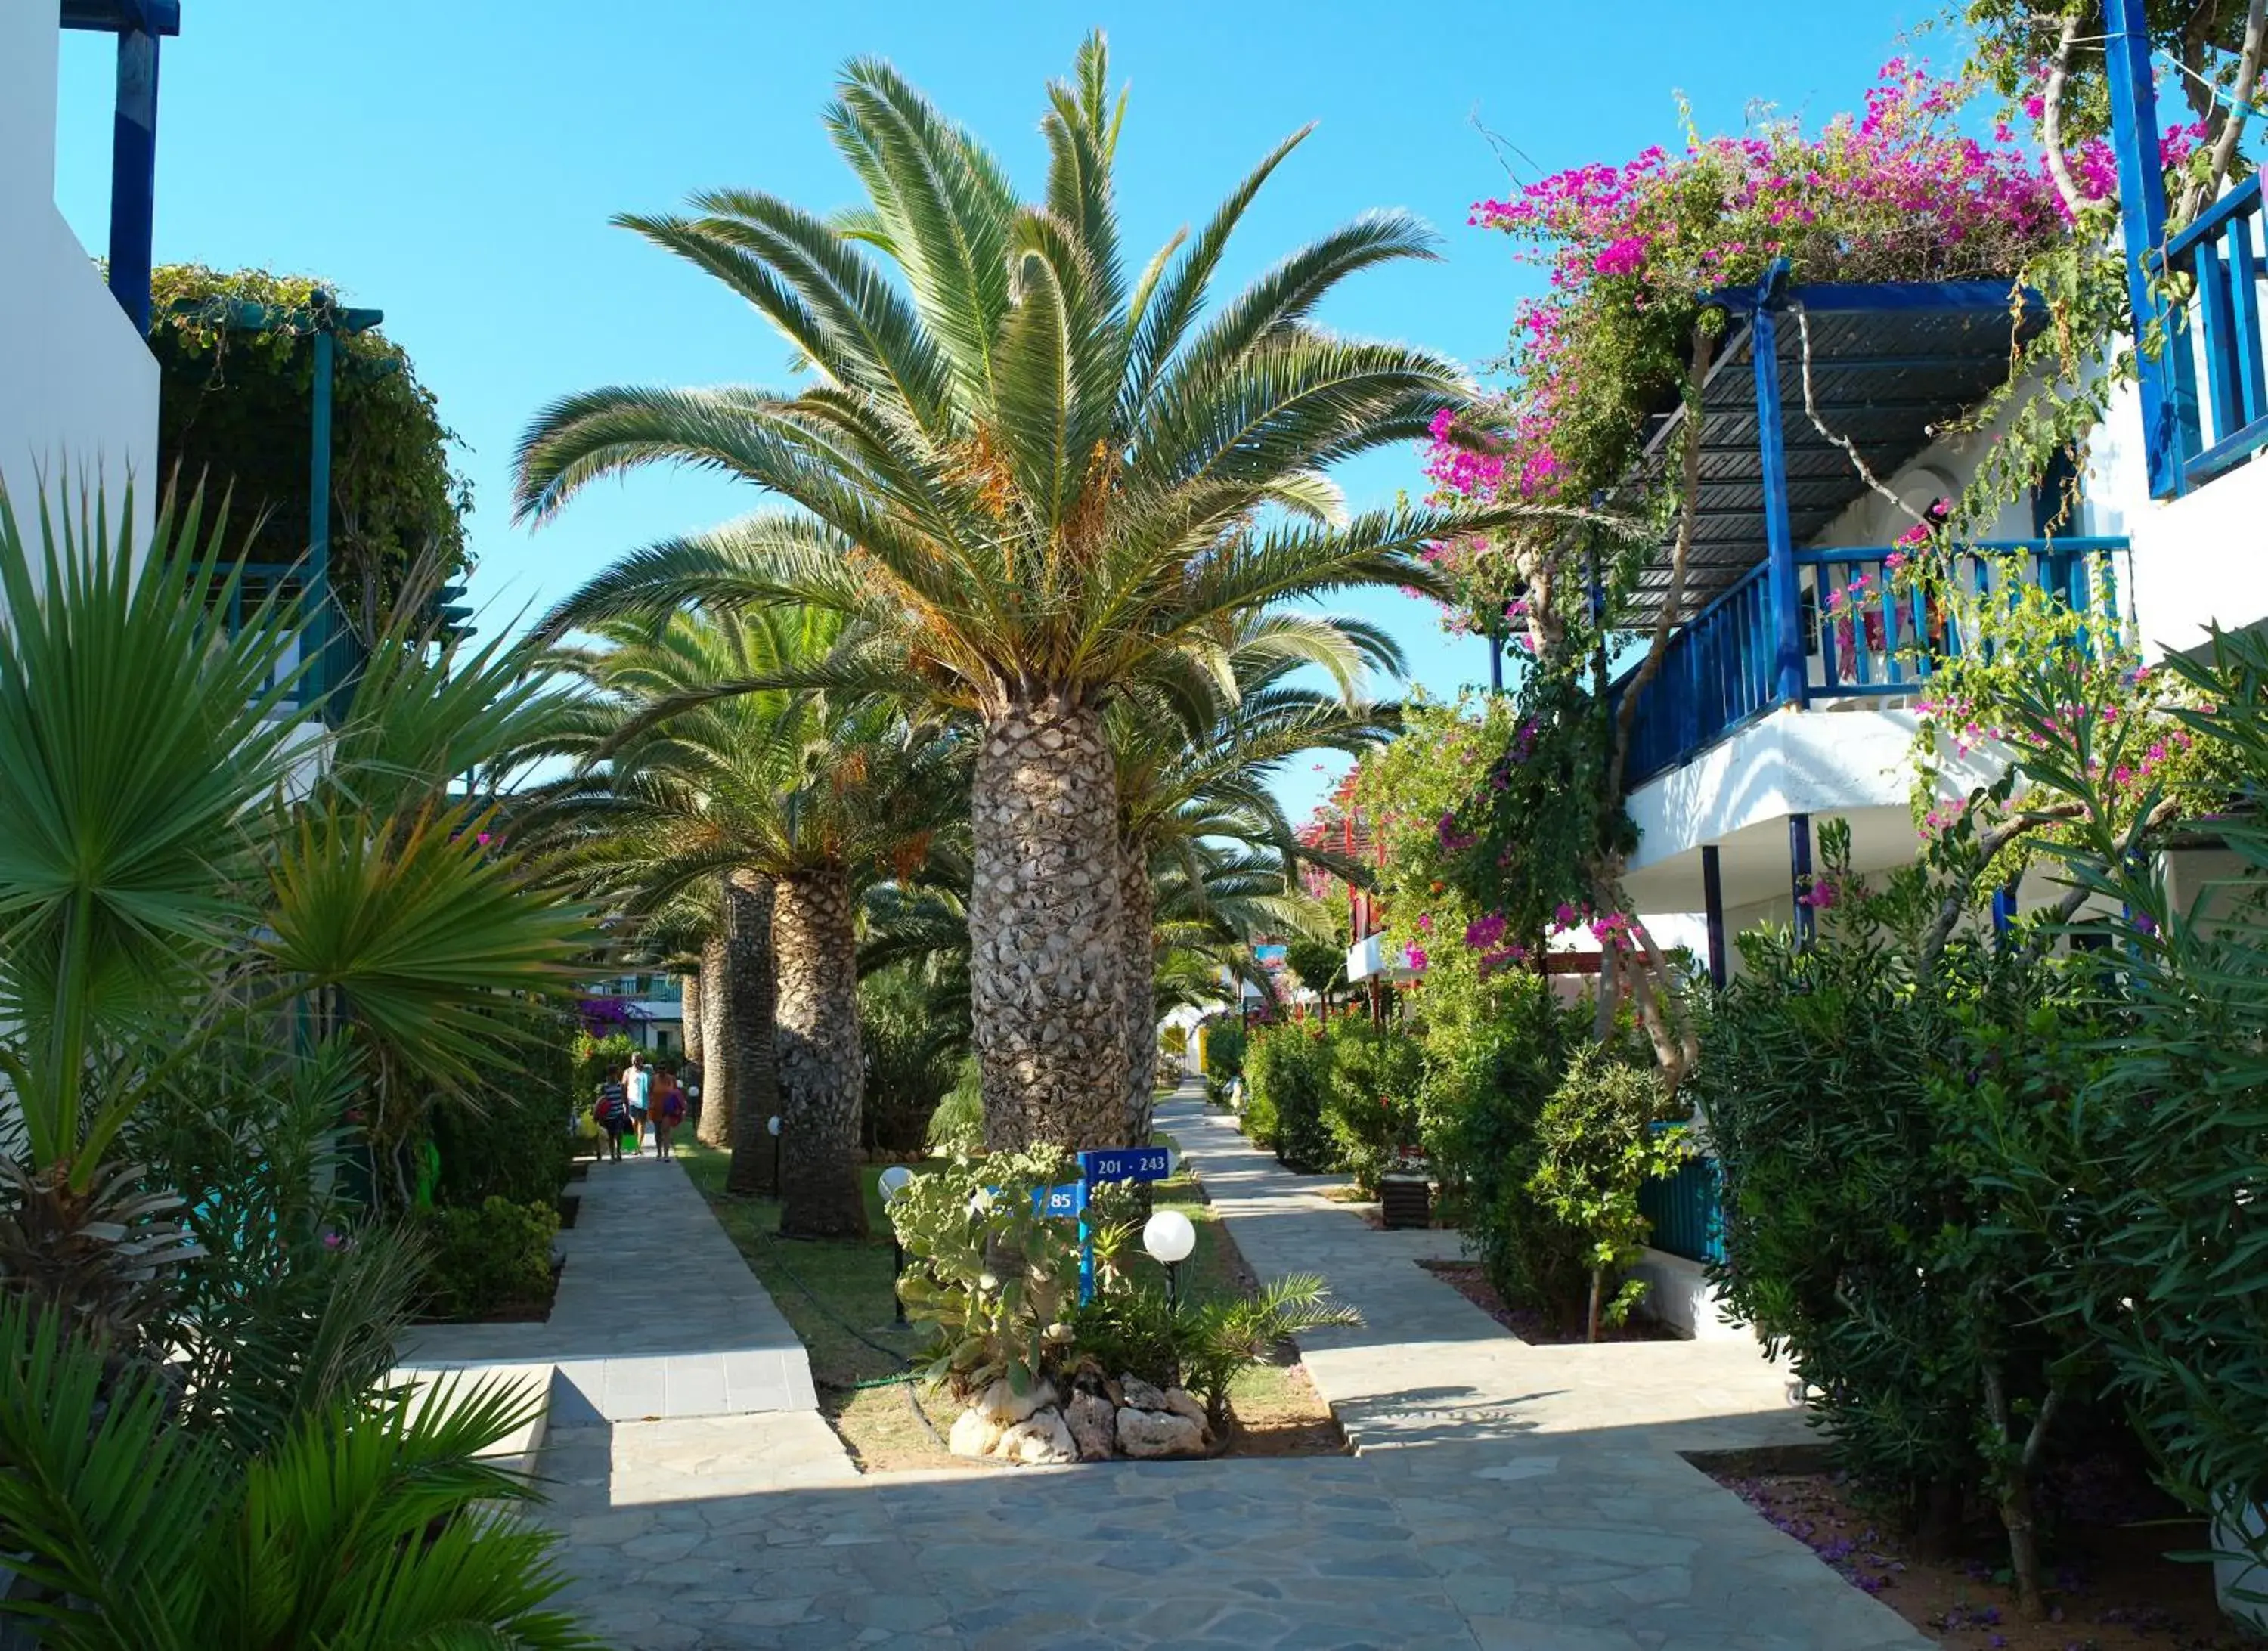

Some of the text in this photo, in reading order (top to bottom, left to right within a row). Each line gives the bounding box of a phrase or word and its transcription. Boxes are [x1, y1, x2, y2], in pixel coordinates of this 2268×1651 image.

[1098, 1160, 1121, 1174] 201
[1139, 1156, 1165, 1171] 243
[1047, 1194, 1071, 1207] 85
